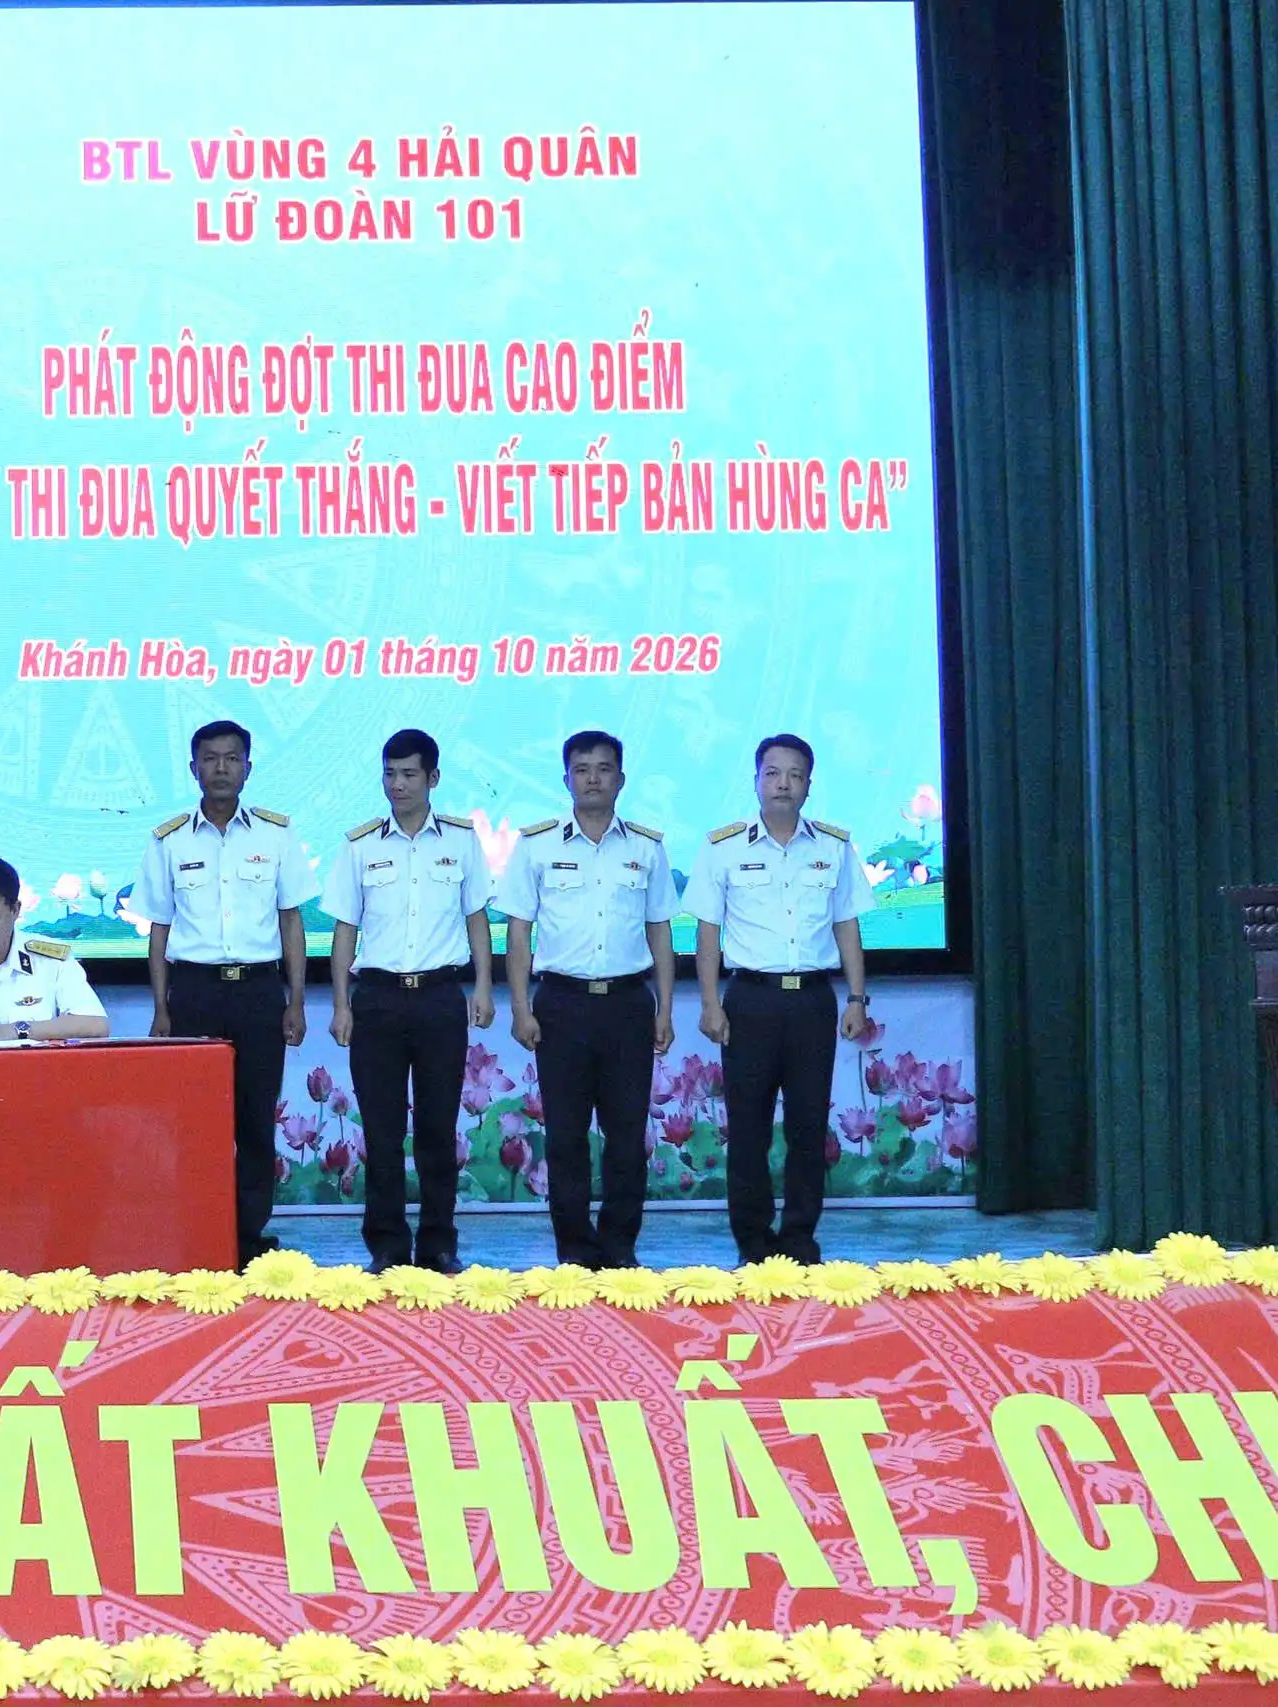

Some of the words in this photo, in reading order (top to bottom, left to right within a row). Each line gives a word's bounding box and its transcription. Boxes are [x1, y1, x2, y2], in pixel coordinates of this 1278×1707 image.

[83, 139, 172, 180] BTL
[191, 130, 327, 180] VÙNG
[348, 139, 377, 178] 4
[399, 125, 481, 177] HẢI
[503, 126, 637, 182] QUÂN
[196, 191, 257, 242] LỮ
[275, 193, 412, 241] ĐOÀN
[436, 199, 521, 240] 101
[43, 329, 136, 415] PHÁT
[149, 329, 249, 431] ĐỘNG
[262, 335, 334, 430] ĐỢT
[346, 344, 404, 413] THI
[417, 343, 493, 413] ĐUA
[506, 342, 577, 412] CAO
[590, 309, 684, 411] ĐIỂM
[8, 468, 67, 537] THI
[79, 468, 155, 537] ĐUA
[168, 439, 284, 545] QUYẾT
[296, 438, 416, 536] THẮNG
[458, 436, 536, 533] VIẾT
[549, 436, 628, 532] TIẾP
[643, 441, 714, 531] BẢN
[728, 444, 826, 531] HÙNG
[840, 459, 908, 530] CA”
[20, 641, 128, 677] Khánh
[139, 641, 217, 682] Hòa,
[230, 647, 313, 684] ngày
[325, 640, 365, 676] 01
[381, 639, 478, 682] tháng
[494, 638, 536, 674] 10
[546, 639, 619, 673] năm
[630, 636, 720, 672] 2026
[267, 1334, 979, 1616] KHUẤT,
[991, 1391, 1278, 1587] CH
